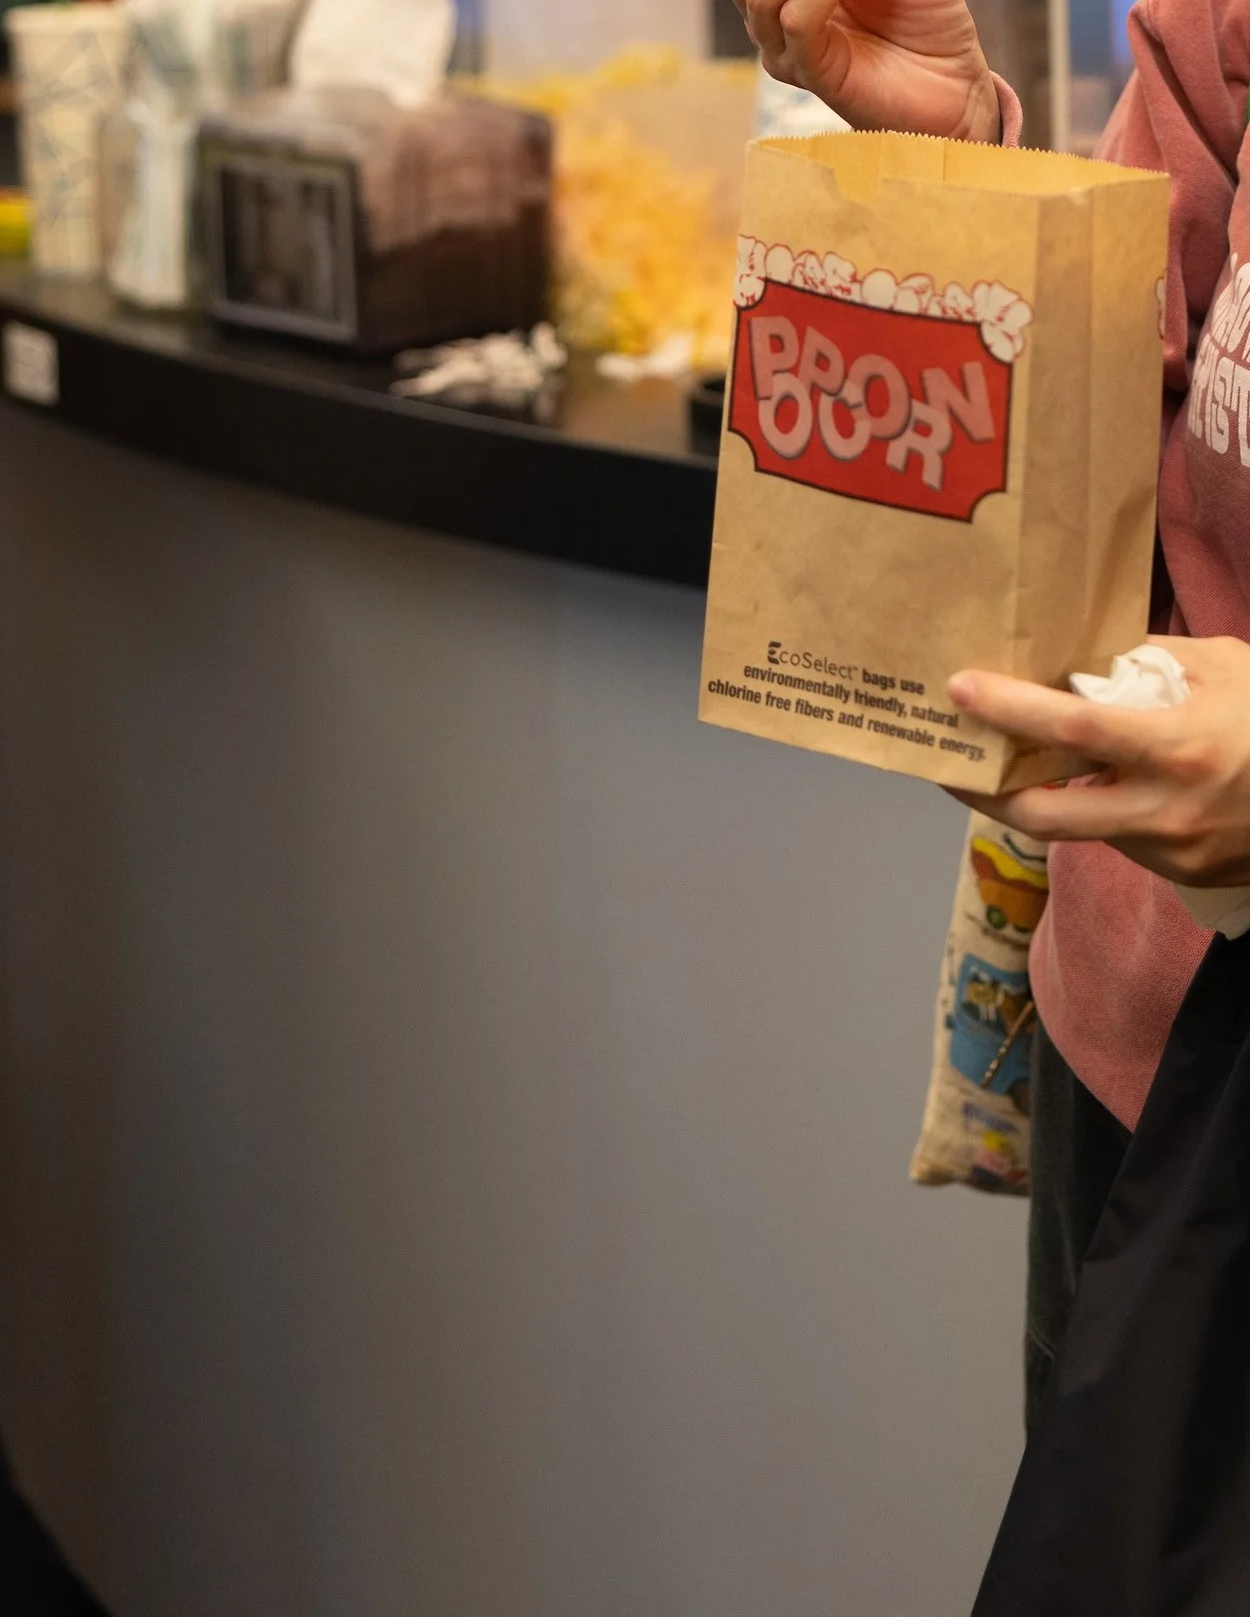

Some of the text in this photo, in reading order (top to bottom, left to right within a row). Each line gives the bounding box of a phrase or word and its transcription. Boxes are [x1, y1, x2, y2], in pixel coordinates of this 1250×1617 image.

[743, 664, 959, 728] environmentally friendly, natural
[862, 667, 896, 691] bags
[900, 678, 925, 696] use
[707, 678, 986, 762] chlorine free fibers and renewable energy.
